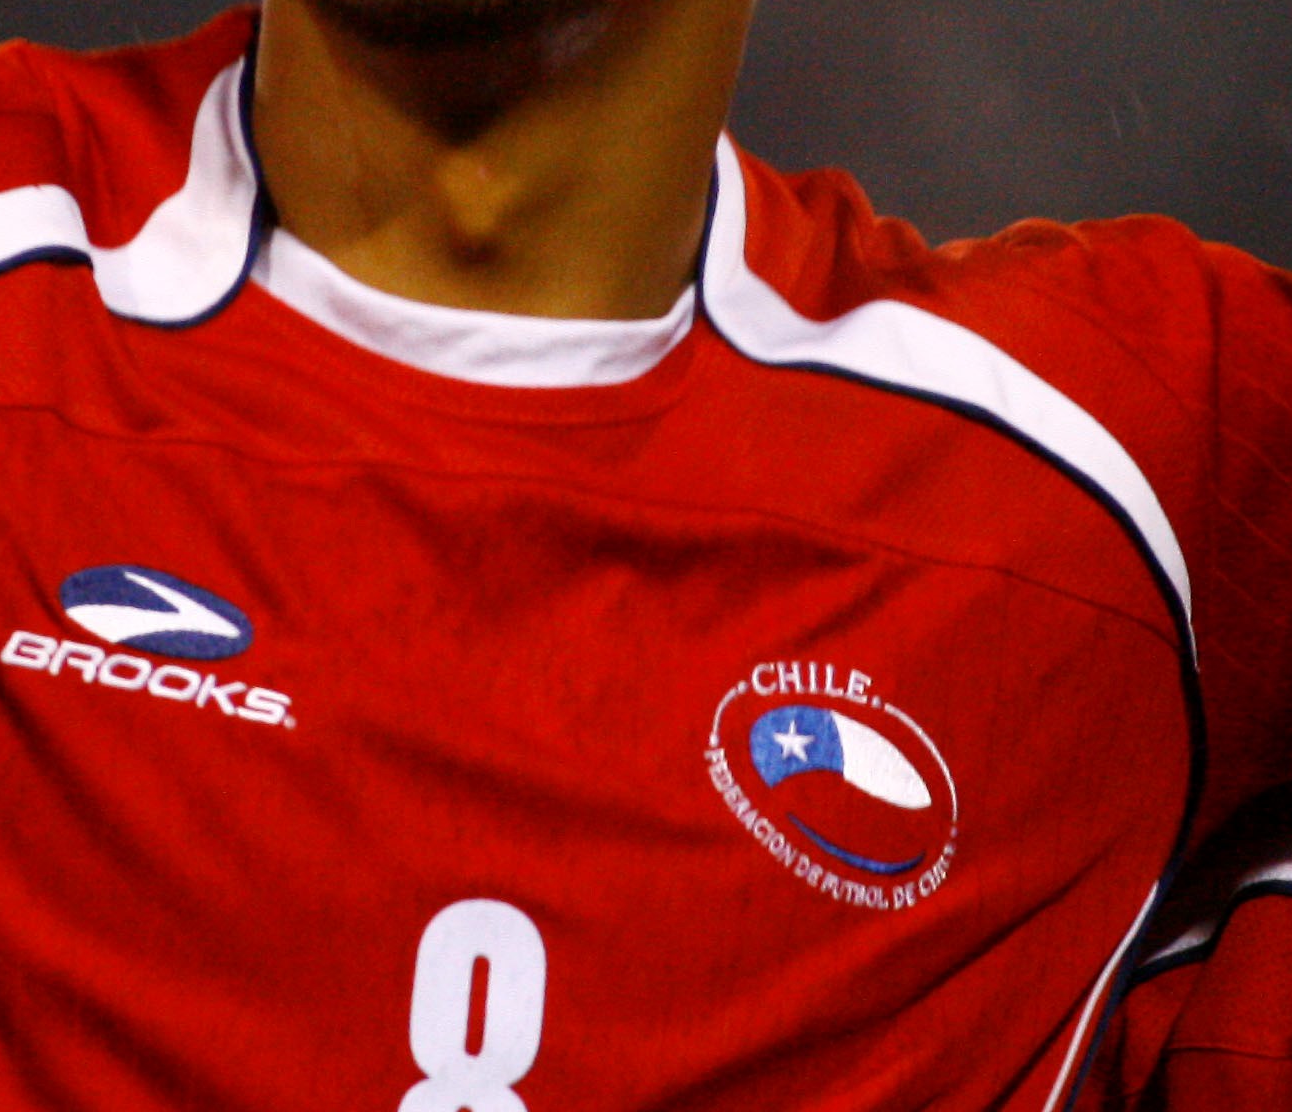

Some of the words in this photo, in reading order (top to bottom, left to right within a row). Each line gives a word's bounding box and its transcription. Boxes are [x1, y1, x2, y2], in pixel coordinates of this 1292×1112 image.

[0, 630, 292, 725] BROOKS
[751, 661, 872, 705] CHILE
[704, 748, 798, 868] FEDERACION
[794, 854, 824, 887] DE
[892, 882, 917, 909] DE
[397, 898, 548, 1112] 8
